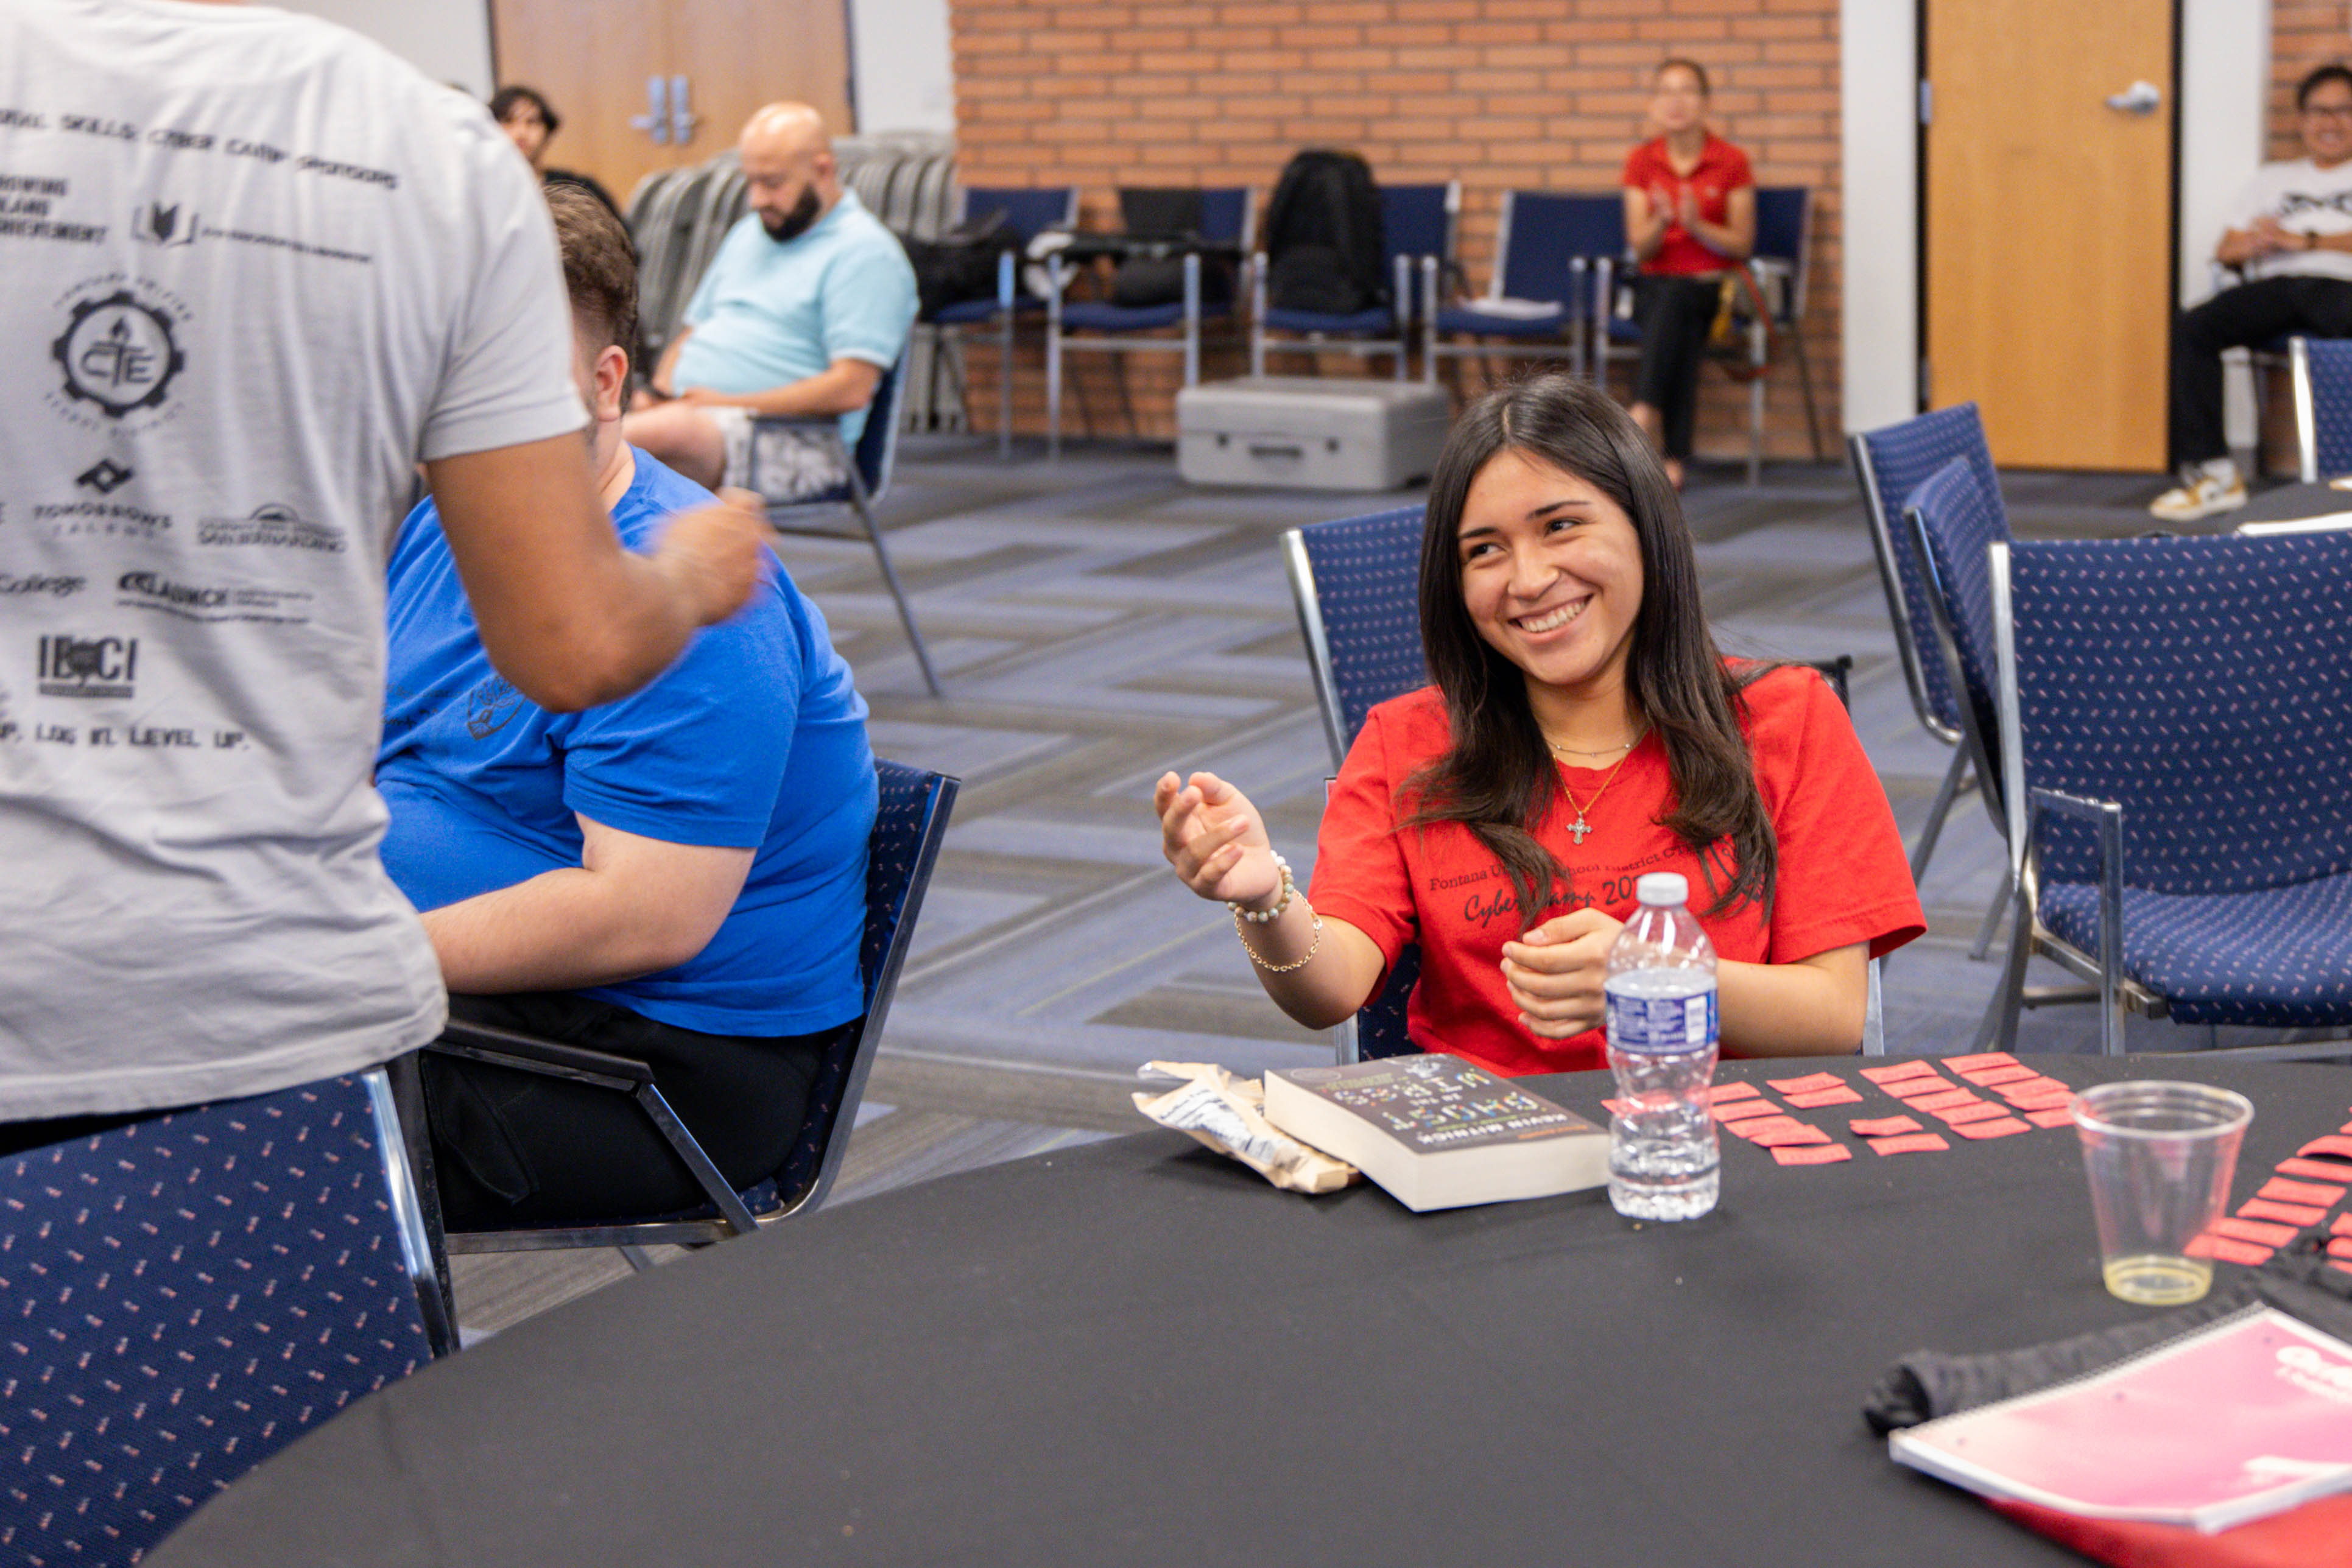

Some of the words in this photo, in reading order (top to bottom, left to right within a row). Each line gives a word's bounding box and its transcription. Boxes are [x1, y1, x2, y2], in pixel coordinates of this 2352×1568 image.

[129, 728, 200, 747] LEVEL
[1429, 869, 1487, 890] Fontana
[1465, 888, 1522, 929] Cyber
[1382, 1092, 1539, 1131] GHOST
